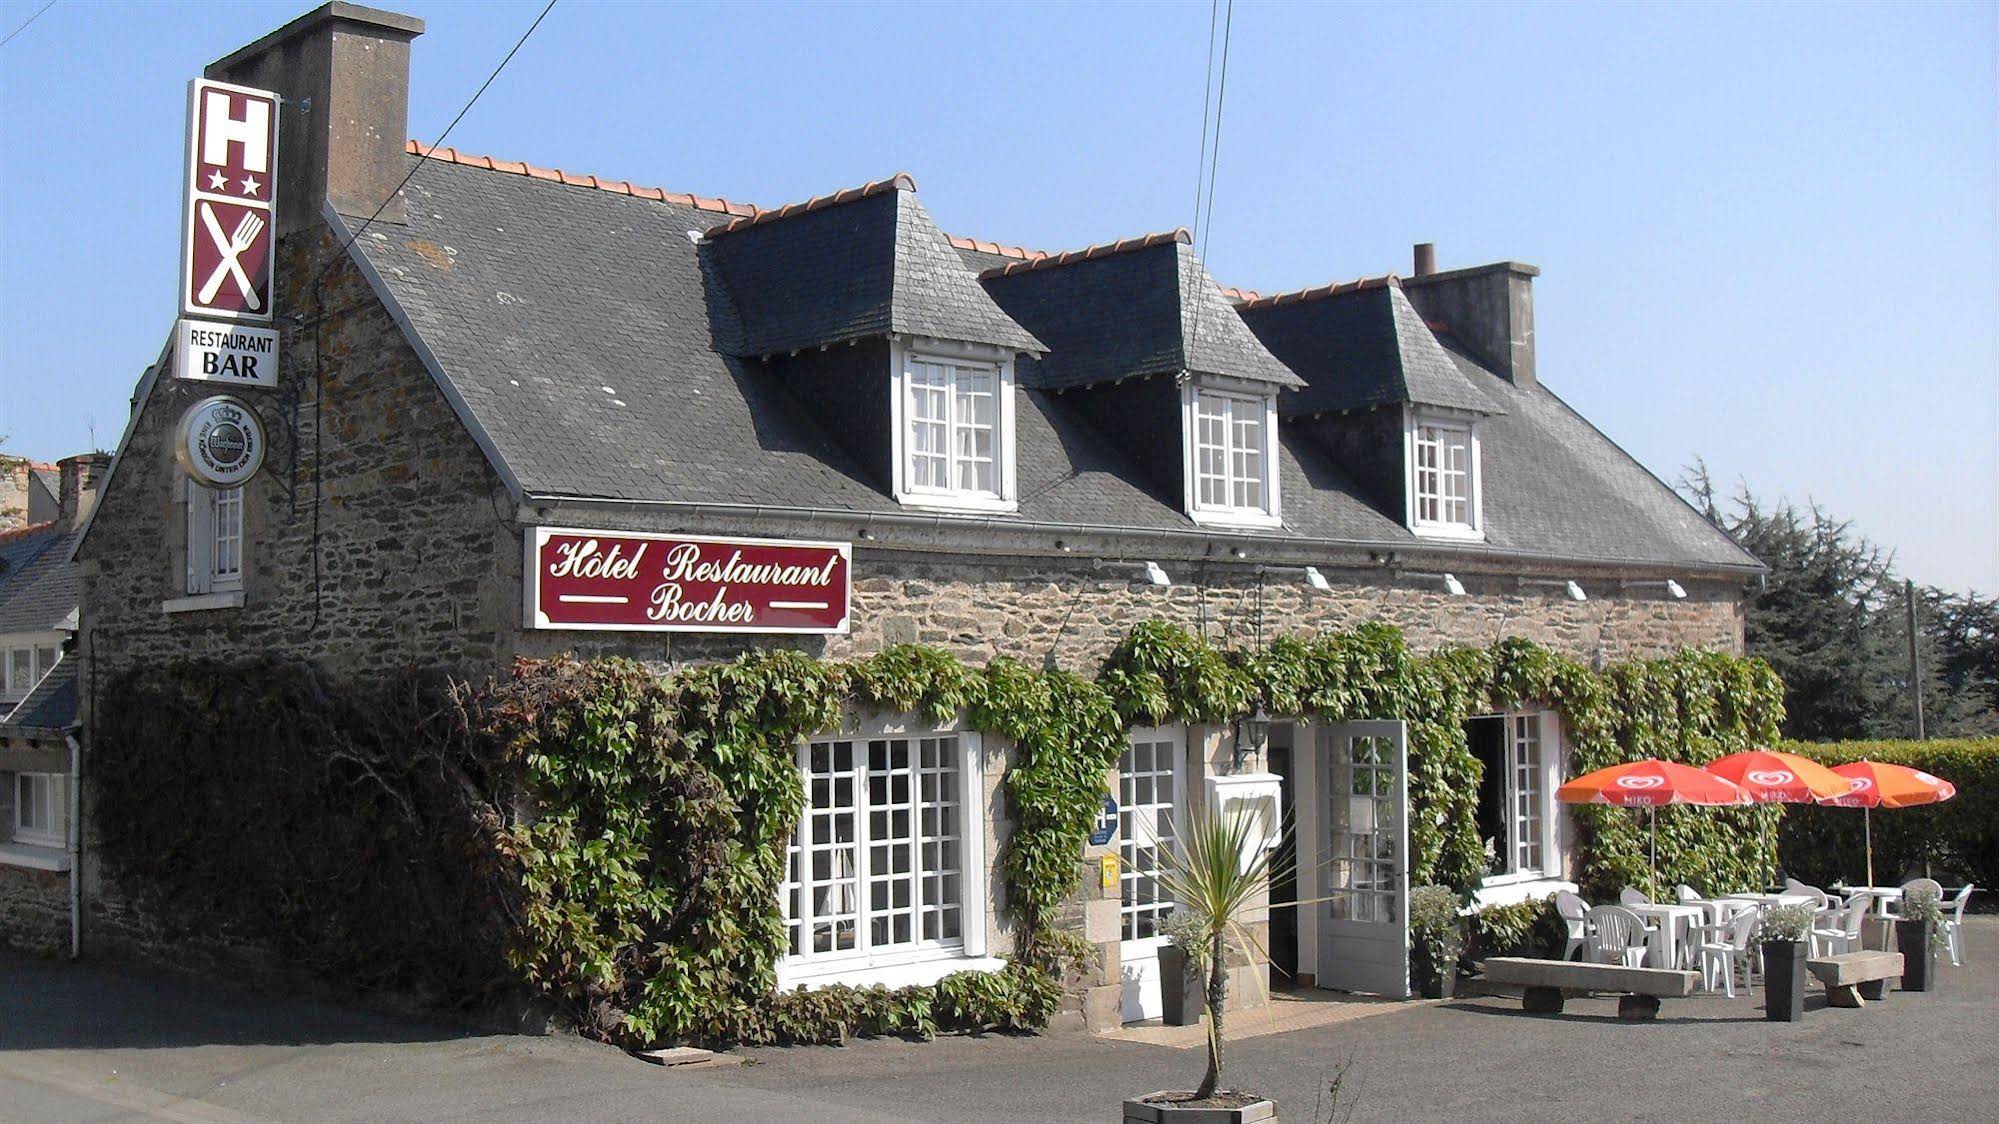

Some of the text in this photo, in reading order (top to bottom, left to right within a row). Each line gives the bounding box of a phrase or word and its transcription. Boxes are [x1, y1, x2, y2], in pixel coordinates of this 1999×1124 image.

[204, 91, 270, 173] H
[191, 329, 273, 353] RESTAURANT
[203, 352, 259, 379] BAR
[215, 464, 239, 474] UNTER
[550, 539, 838, 586] Hôtel Restaurant
[647, 582, 754, 622] Bocher
[1624, 795, 1651, 806] MIKO
